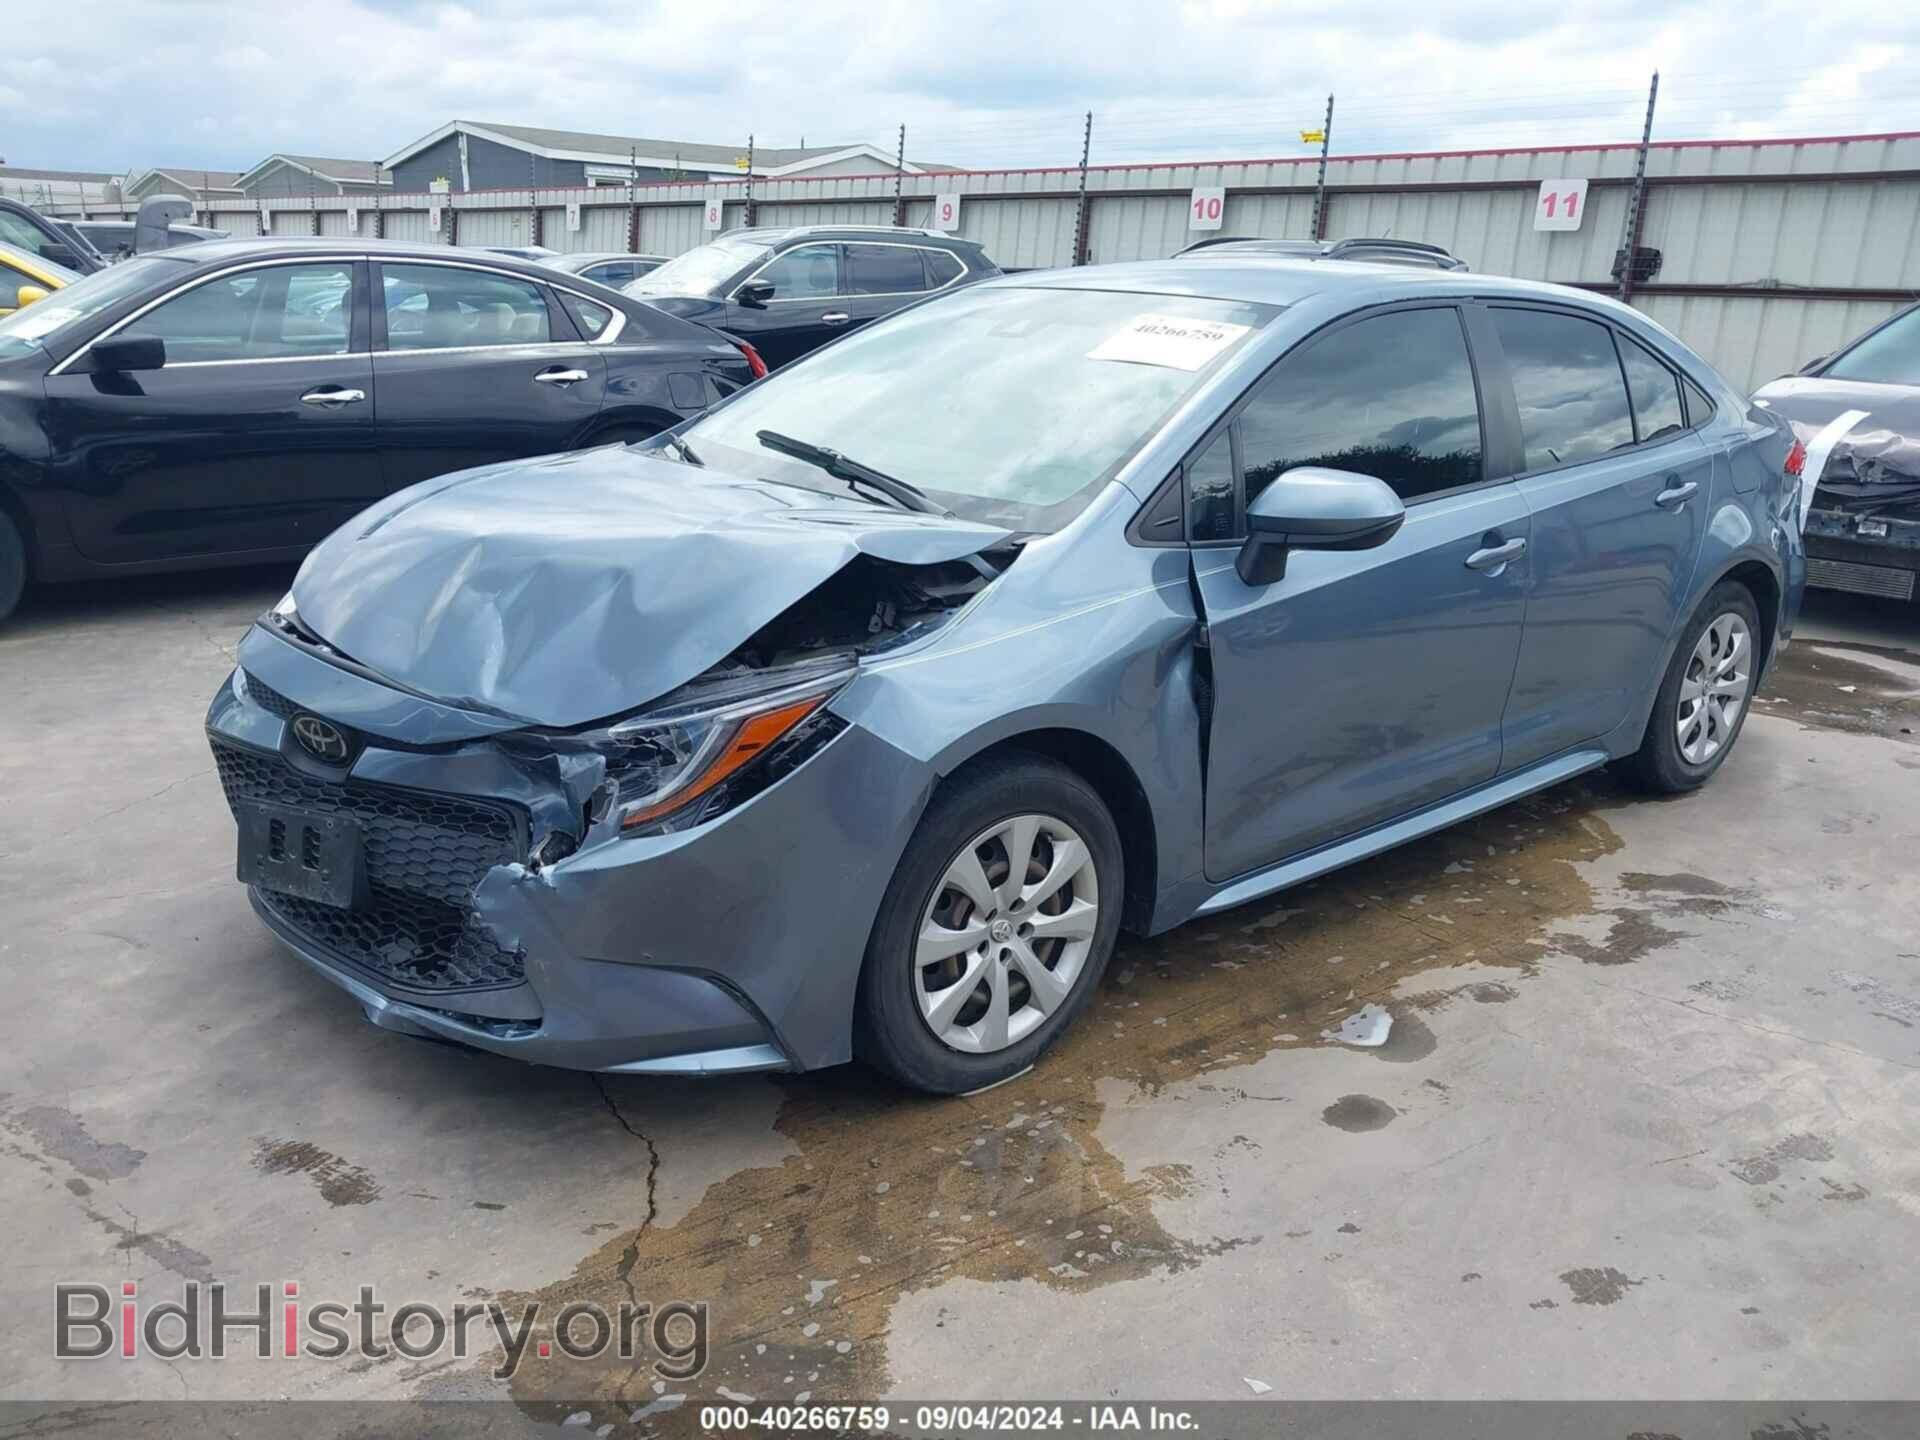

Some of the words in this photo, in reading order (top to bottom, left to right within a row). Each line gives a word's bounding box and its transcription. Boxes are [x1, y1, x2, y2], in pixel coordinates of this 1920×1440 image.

[943, 203, 952, 221] 9
[1194, 198, 1221, 220] 10
[1542, 191, 1578, 218] 11
[569, 210, 576, 225] 7
[710, 207, 717, 223] 8
